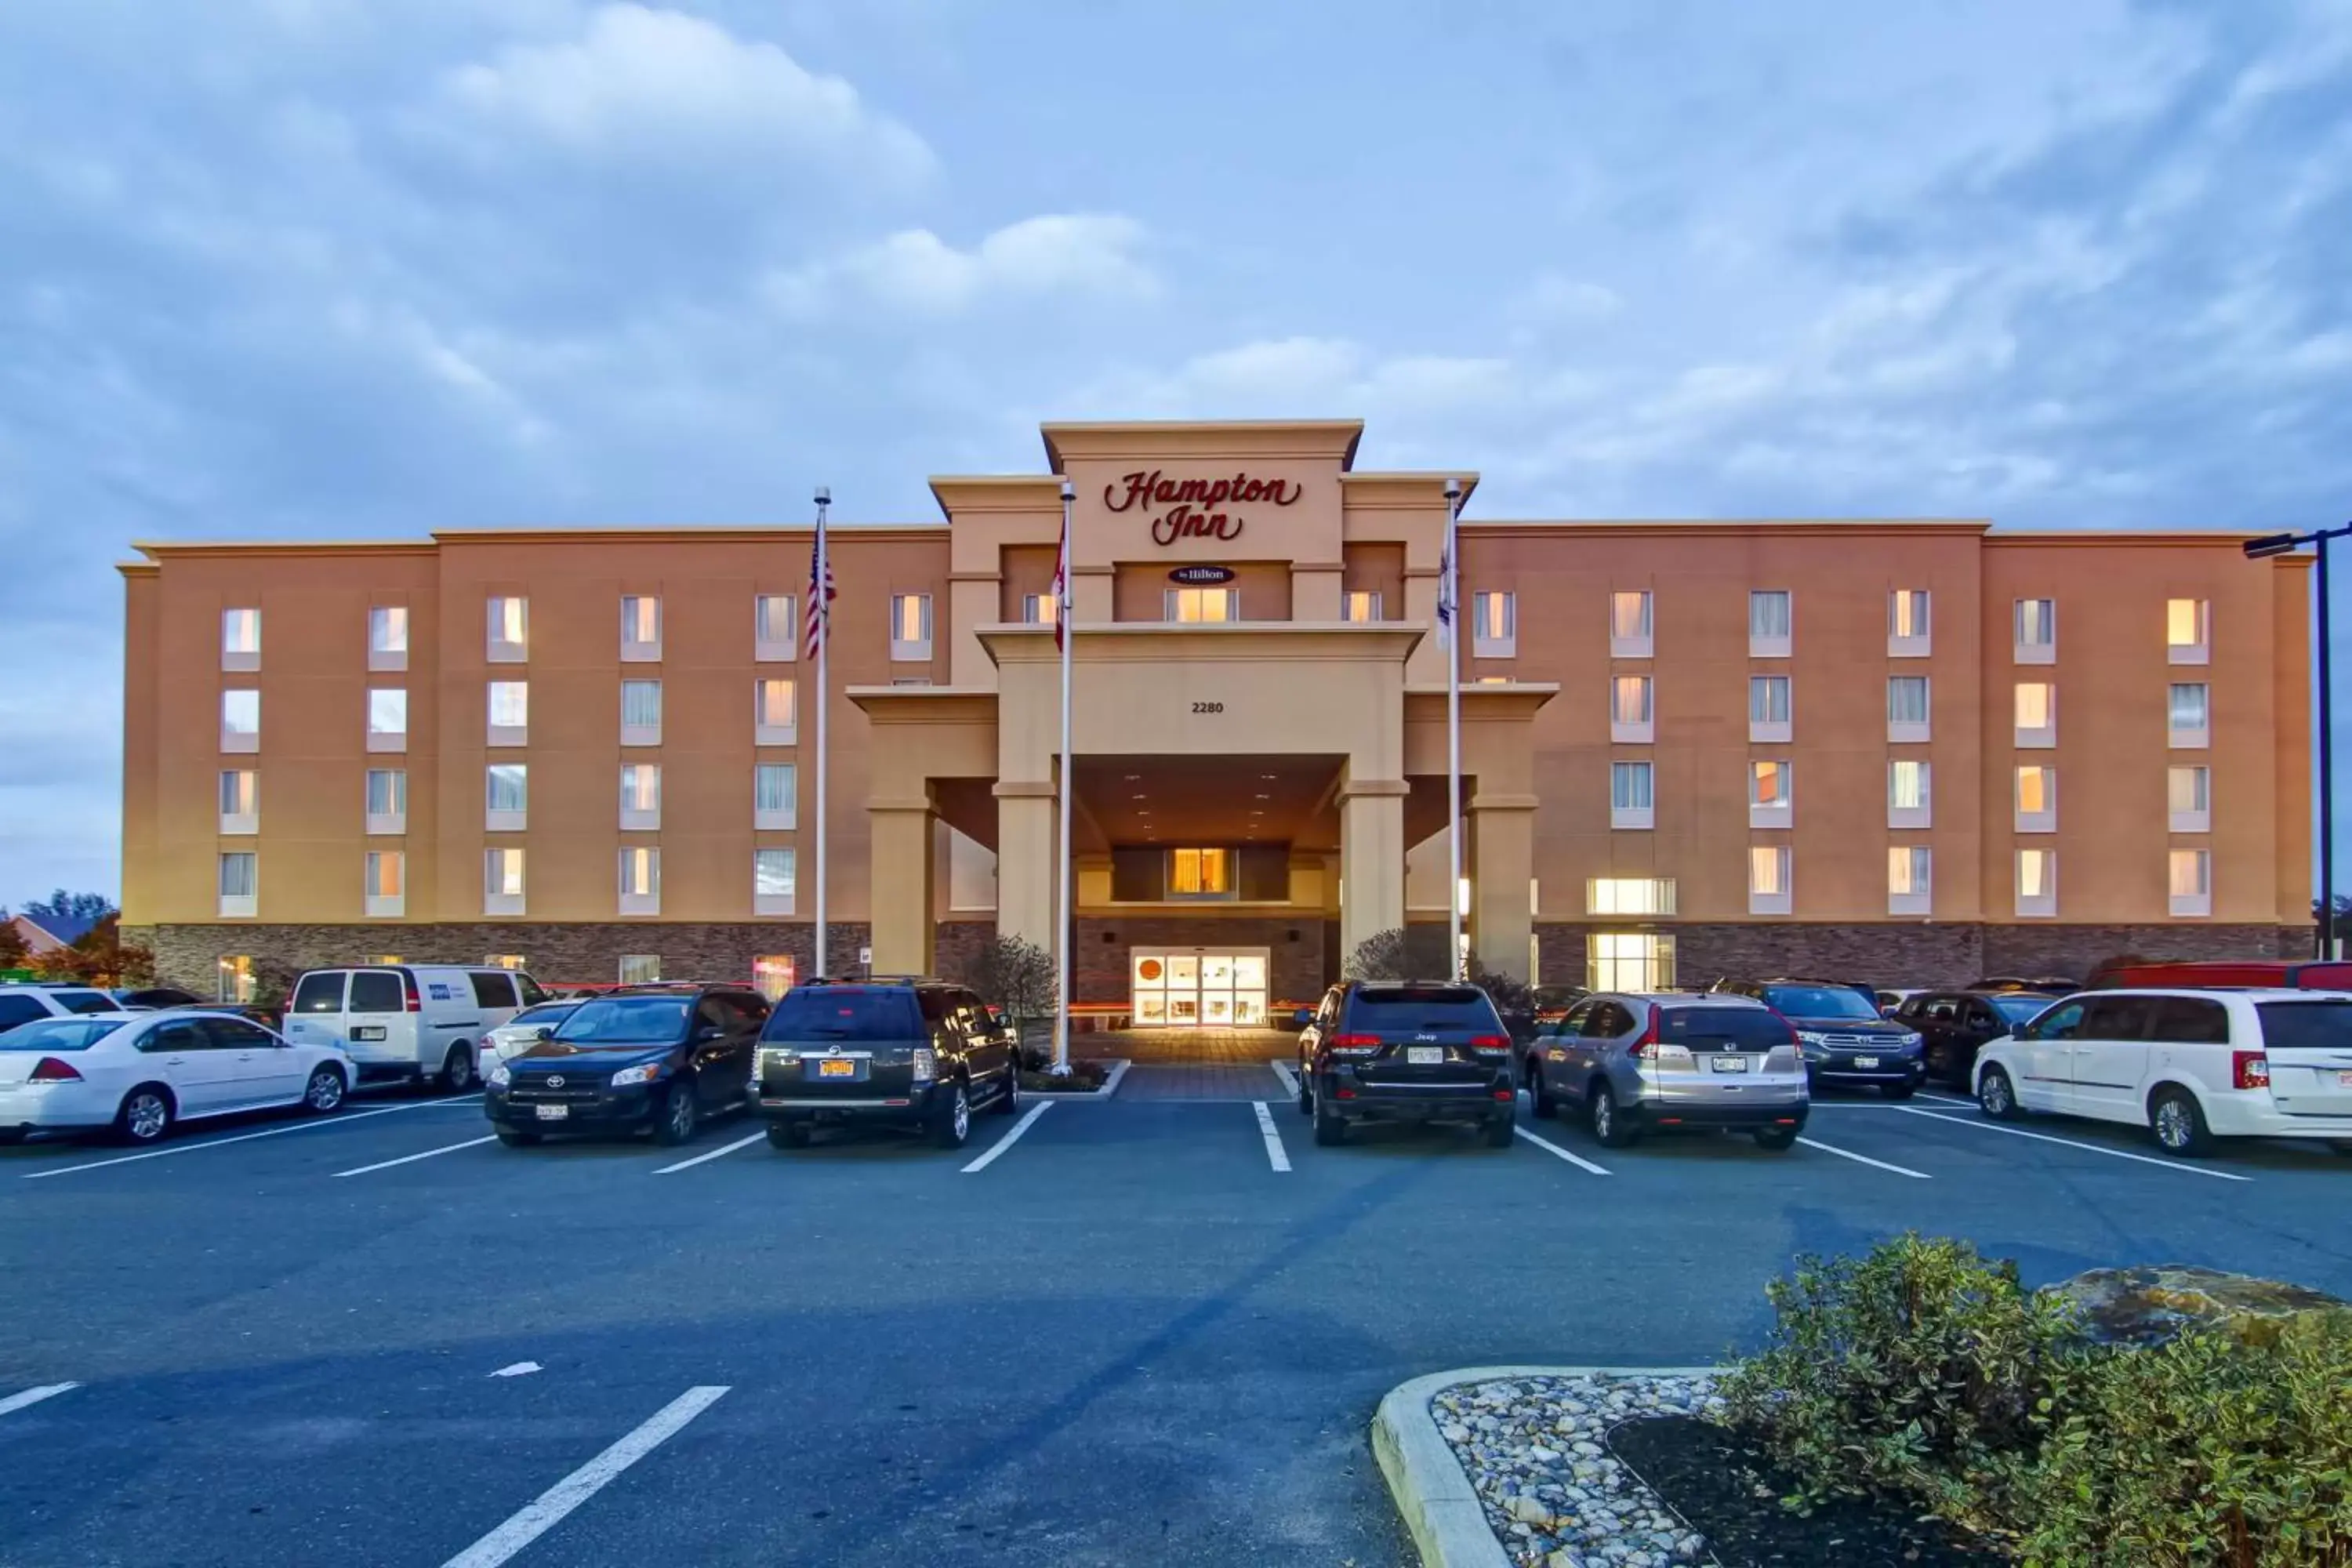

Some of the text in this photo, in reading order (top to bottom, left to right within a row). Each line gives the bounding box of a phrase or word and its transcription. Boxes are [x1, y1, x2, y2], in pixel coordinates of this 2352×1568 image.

[1104, 470, 1301, 513] Hampton
[1152, 505, 1243, 546] Inn
[1192, 702, 1224, 713] 2280
[1414, 1033, 1437, 1041] Jeep
